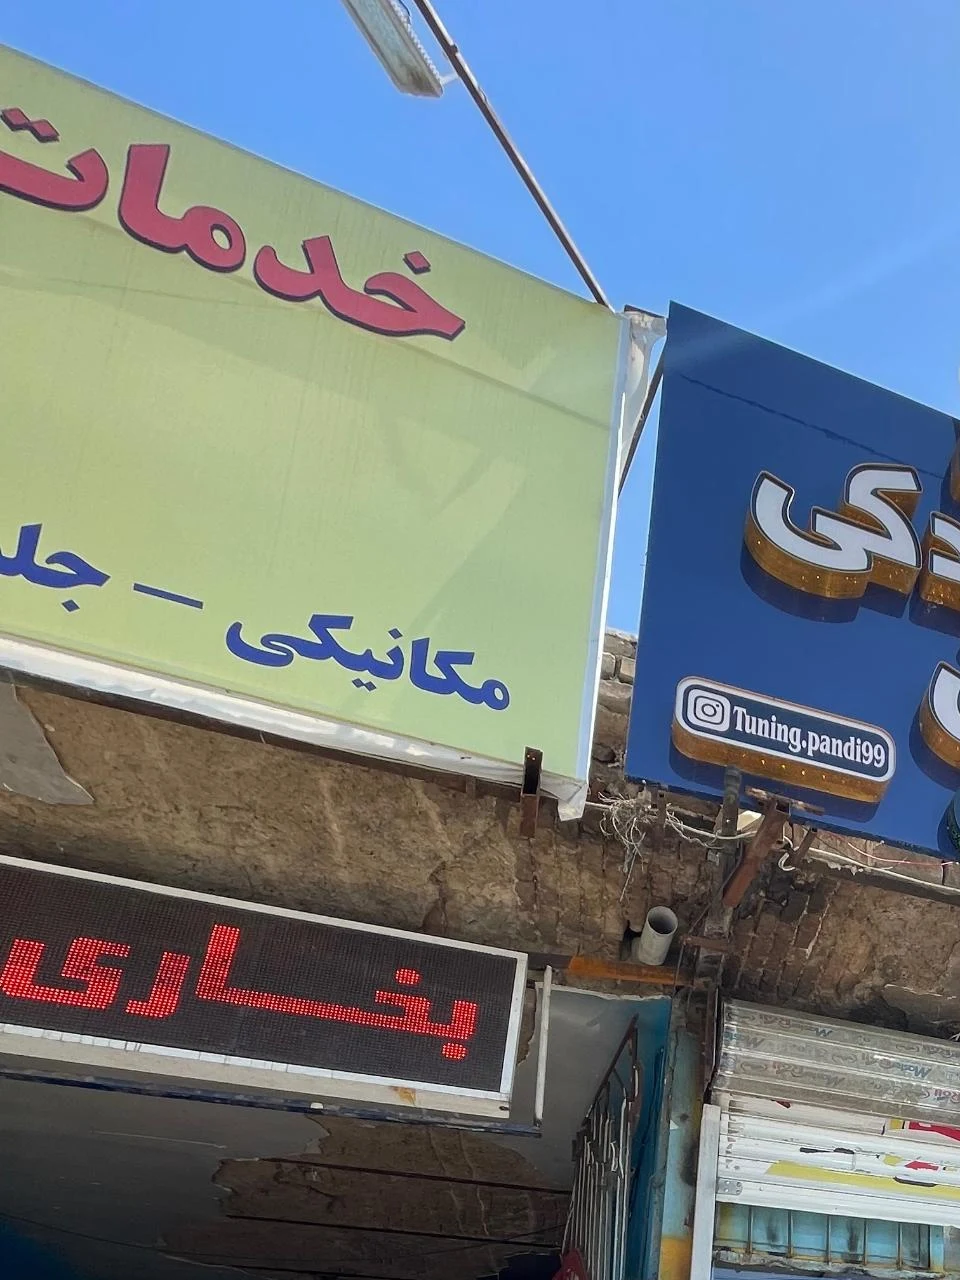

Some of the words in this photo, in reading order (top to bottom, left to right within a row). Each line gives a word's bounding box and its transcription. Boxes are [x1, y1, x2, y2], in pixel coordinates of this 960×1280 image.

[0, 106, 466, 342] خدمات
[225, 614, 511, 711] مکانیکی
[733, 706, 886, 769] Tuning.pandi99
